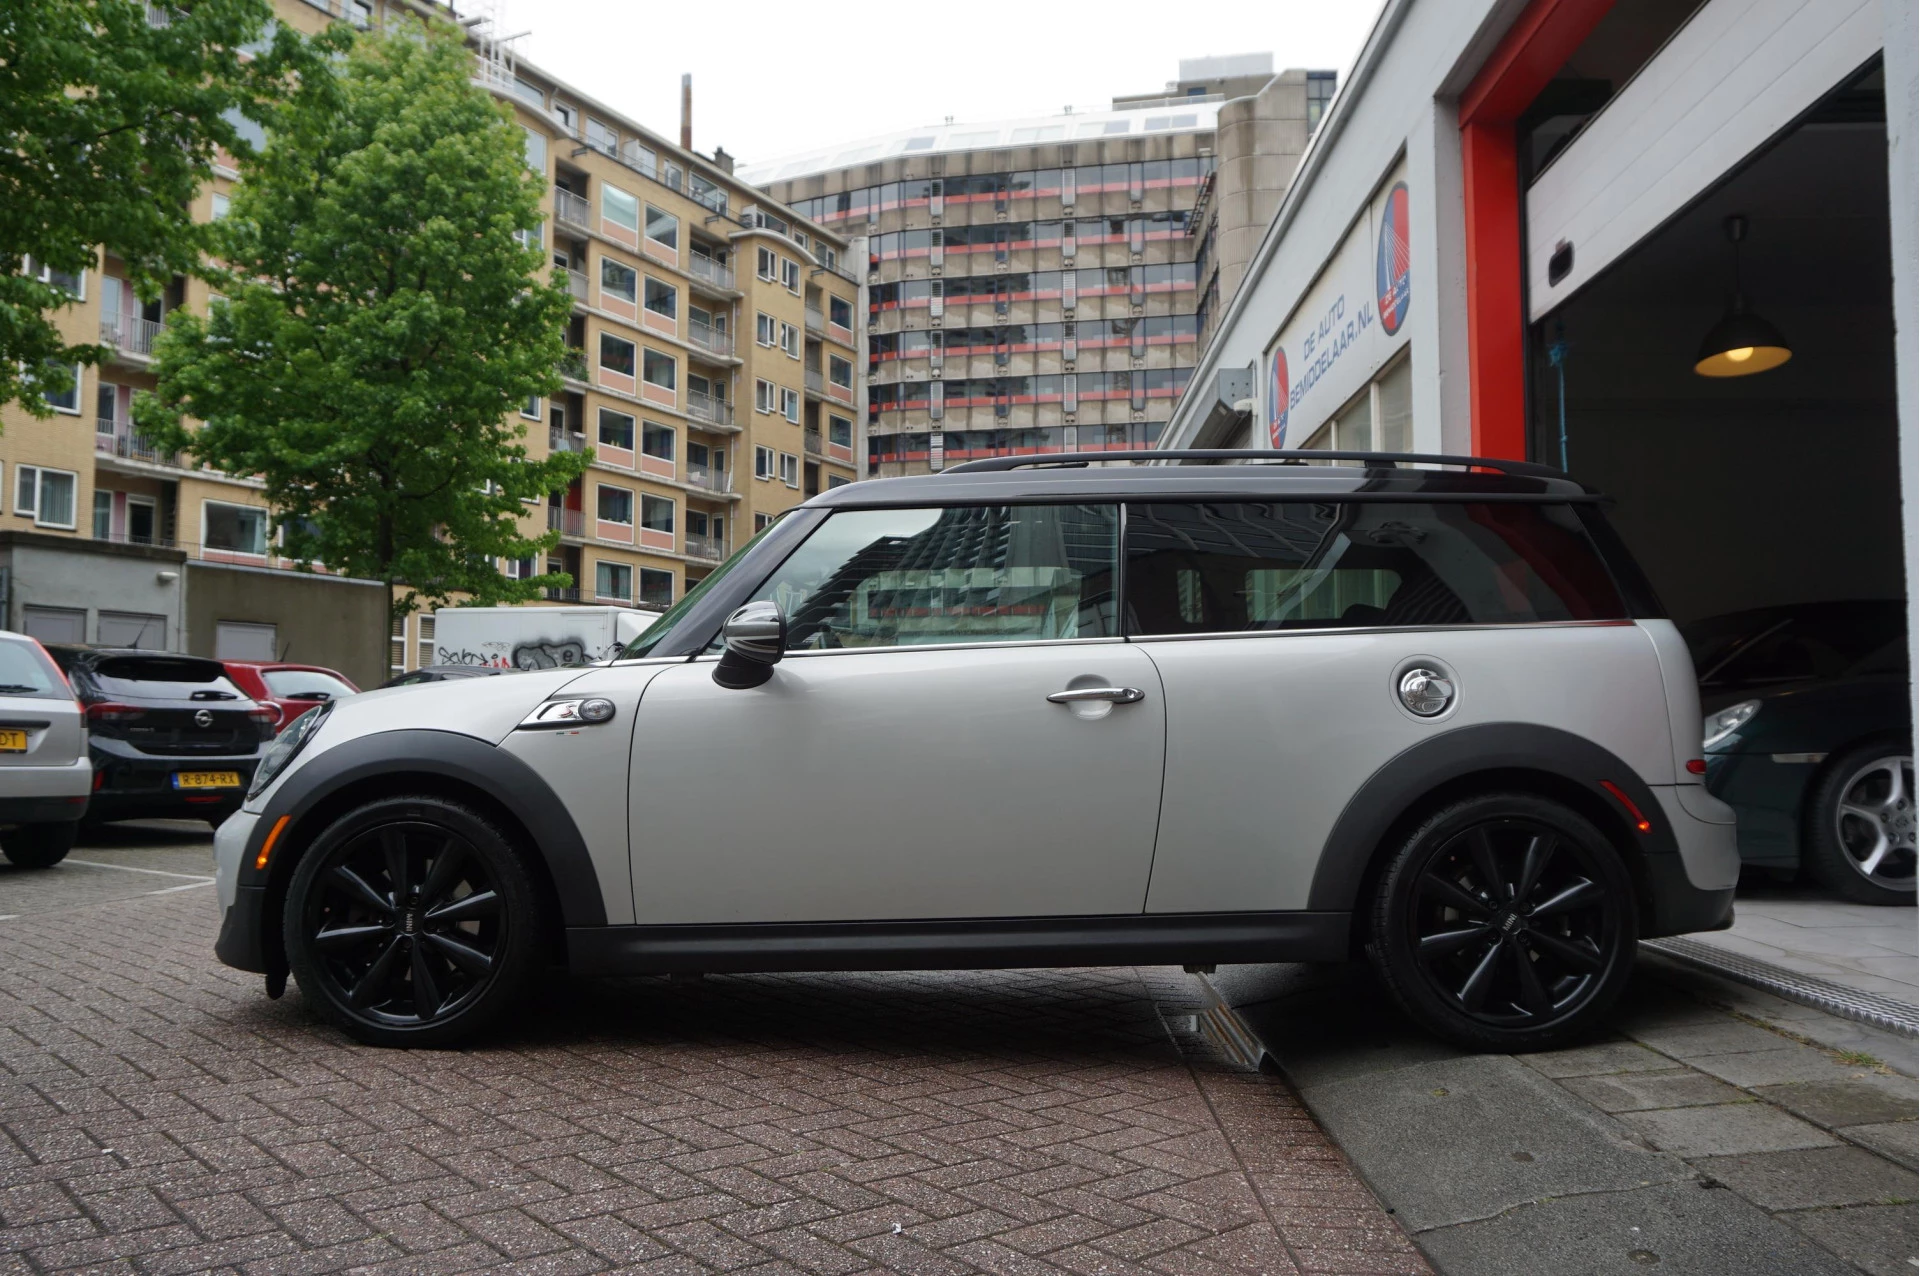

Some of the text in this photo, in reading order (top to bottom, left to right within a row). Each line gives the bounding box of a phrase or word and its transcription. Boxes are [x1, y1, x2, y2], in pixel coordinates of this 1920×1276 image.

[1304, 294, 1345, 361] DE AUTO
[1290, 301, 1374, 410] BEMIDDELAAR.NL
[182, 773, 236, 784] R-874-RX
[405, 913, 414, 932] MINI
[1502, 913, 1518, 931] MINI
